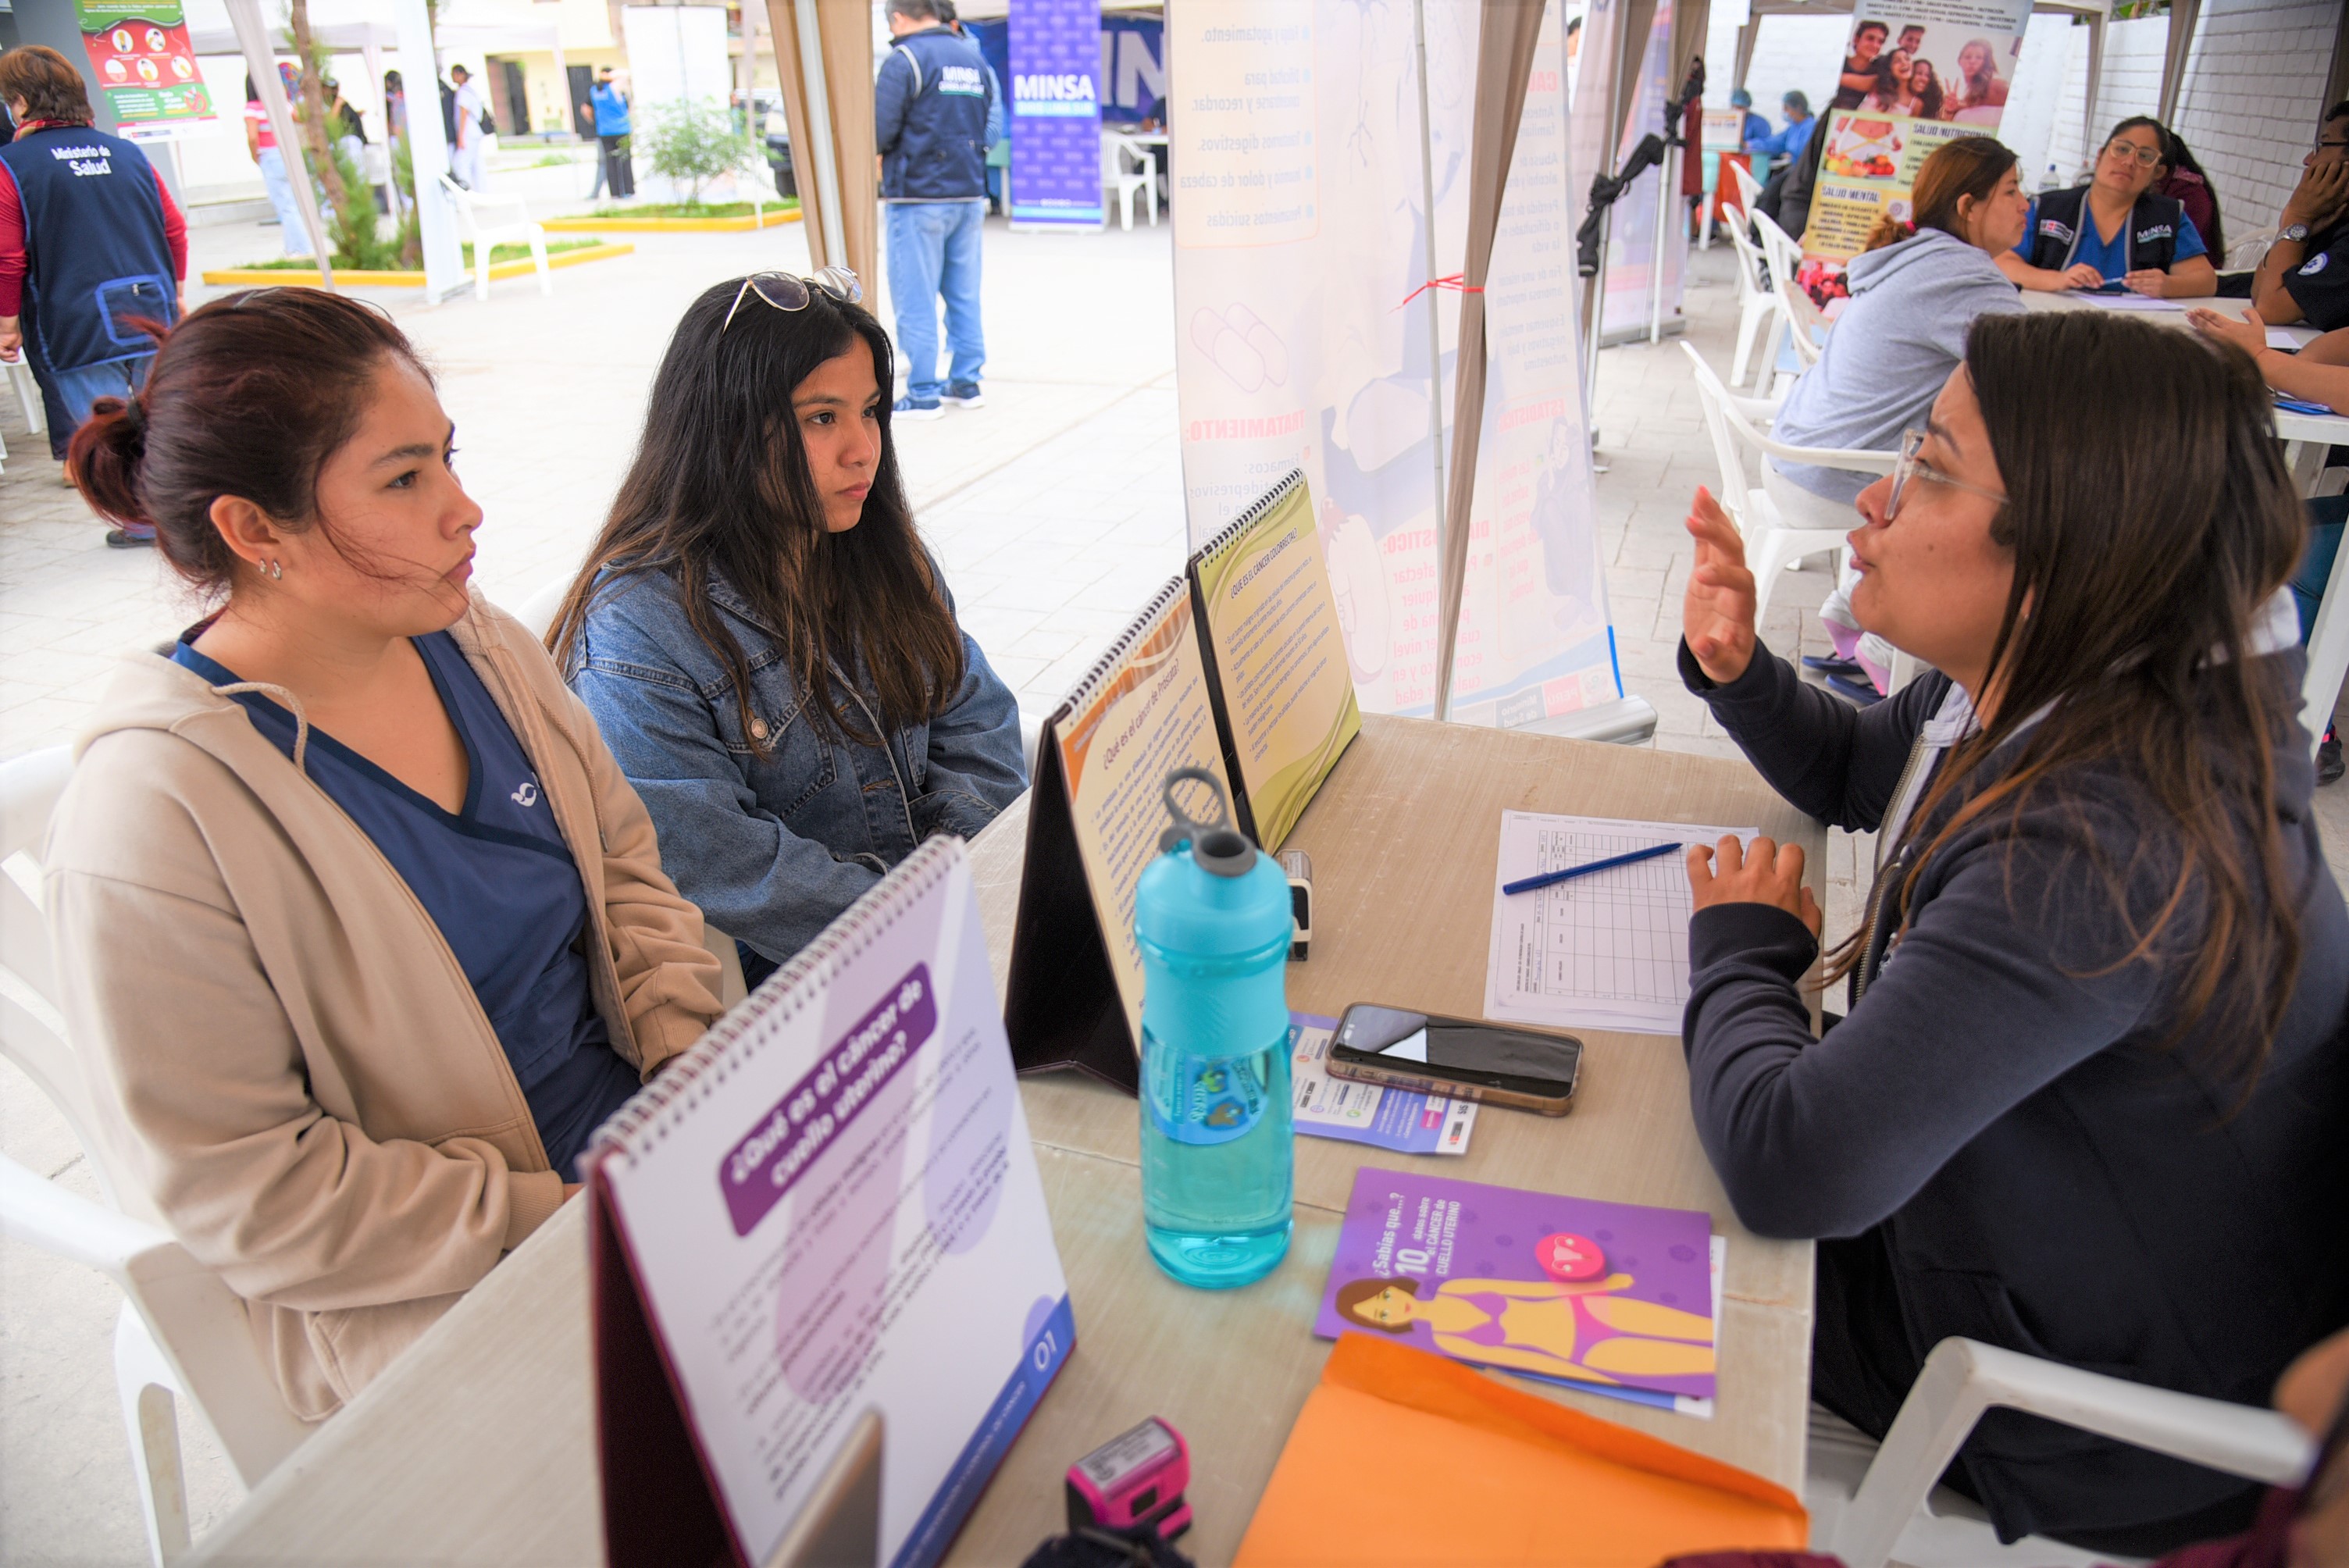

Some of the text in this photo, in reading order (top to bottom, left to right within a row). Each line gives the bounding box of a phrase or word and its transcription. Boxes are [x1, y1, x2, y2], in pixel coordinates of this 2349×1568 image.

[942, 66, 981, 84] MINSA
[1014, 74, 1096, 100] MINSA
[1914, 123, 1937, 136] SALUD
[52, 145, 112, 161] Ministerio de
[69, 158, 112, 176] Salud
[1822, 185, 1880, 203] SALUD MENTAL
[2137, 223, 2172, 241] MINSA
[1242, 573, 1249, 586] ES
[1248, 569, 1253, 581] EL
[1253, 553, 1270, 576] CÁNCER
[1269, 527, 1297, 561] COLORRECTAL?
[1103, 657, 1180, 771] ¿Qué es el cáncer de Próstata?
[733, 980, 922, 1182] ¿Qué es el cáncer de
[772, 1030, 907, 1186] cuello uterino?
[1394, 1196, 1431, 1274] 10 datos sobre
[1424, 1199, 1446, 1256] el CÁNCER de
[1435, 1200, 1461, 1276] CUELLO UTERINO
[1372, 1230, 1396, 1279] ¿Sabías
[1033, 1329, 1057, 1372] 01
